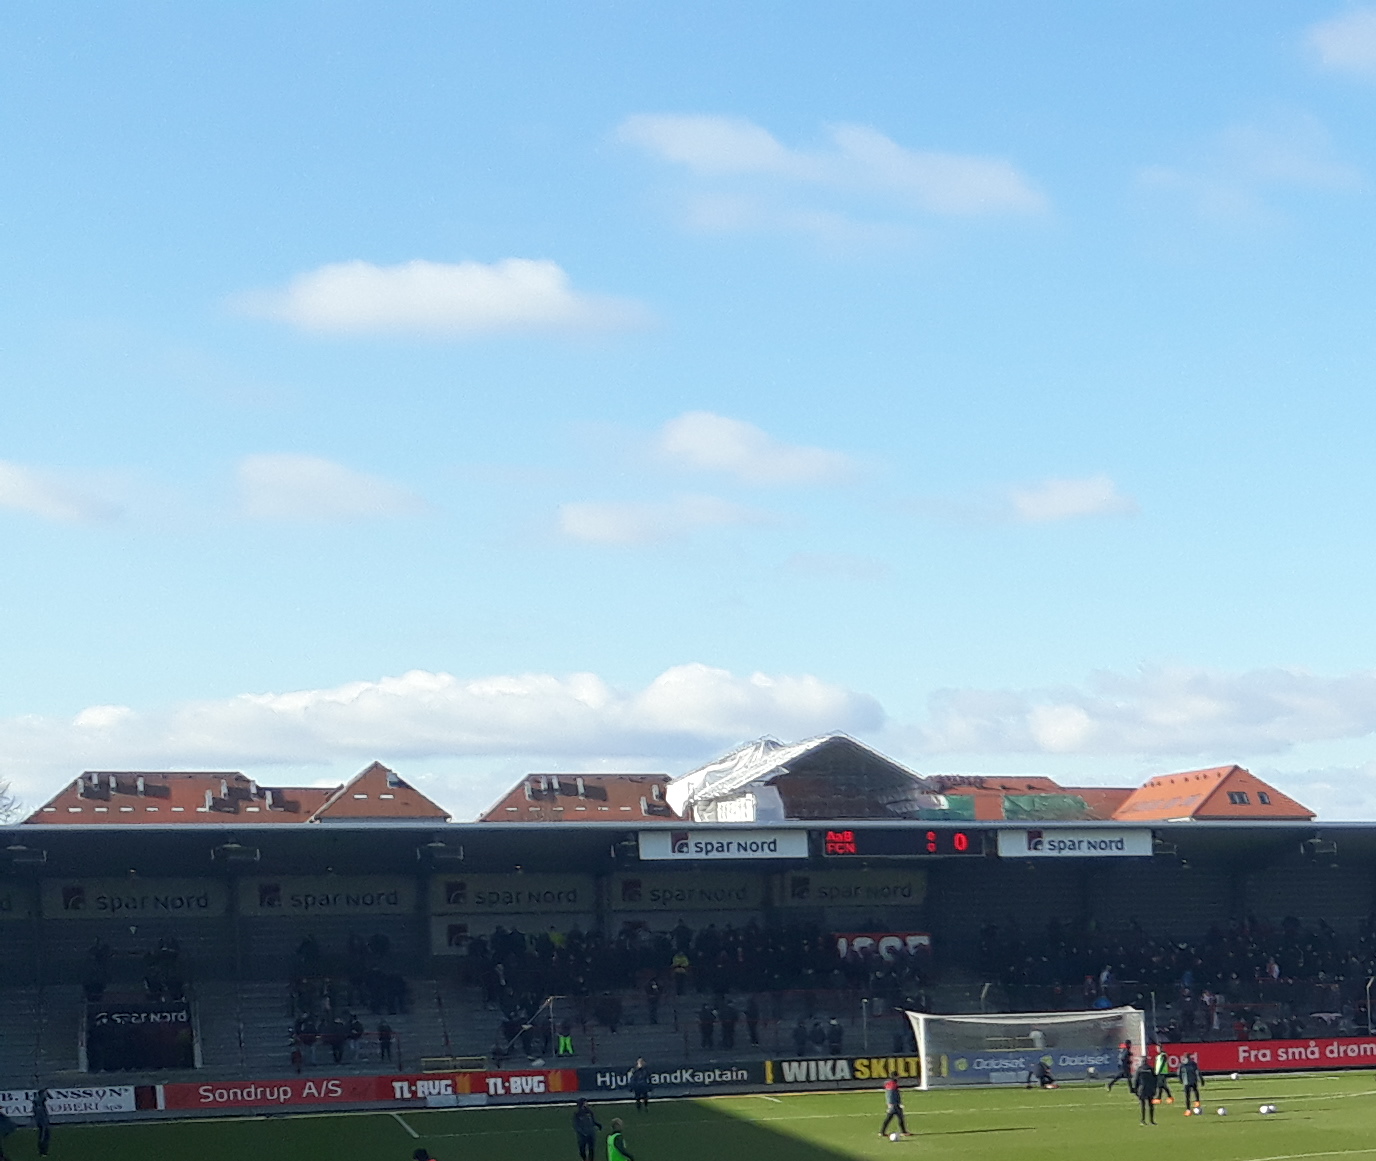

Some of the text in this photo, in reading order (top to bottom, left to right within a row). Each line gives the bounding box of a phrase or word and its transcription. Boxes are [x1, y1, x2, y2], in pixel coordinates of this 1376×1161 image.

[694, 840, 733, 854] spar
[953, 832, 969, 851] 0
[1048, 838, 1084, 852] spar
[1058, 1055, 1110, 1067] Oddset
[1238, 1047, 1272, 1063] Fra
[1277, 1041, 1320, 1060] små
[596, 1066, 748, 1090] HjulandKaptain
[783, 1060, 851, 1083] WIKA
[198, 1080, 342, 1103] Sondrup A/S
